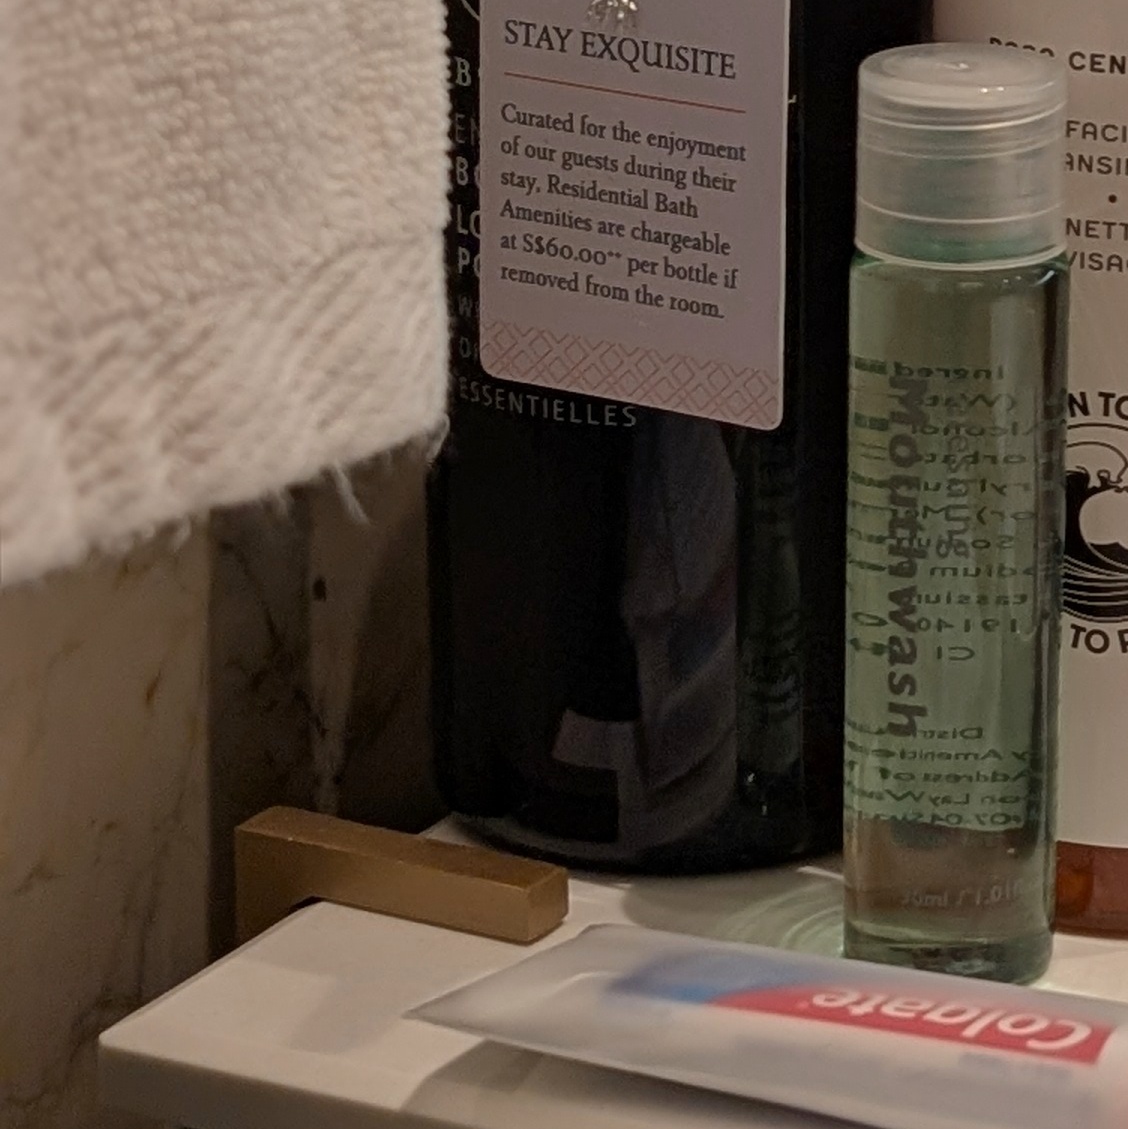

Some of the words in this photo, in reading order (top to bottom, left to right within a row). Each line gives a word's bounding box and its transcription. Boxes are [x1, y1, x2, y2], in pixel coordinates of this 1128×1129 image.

[504, 19, 573, 53] STAY
[580, 31, 737, 80] EXQUISITE
[500, 102, 575, 134] Curated
[579, 114, 606, 140] for
[612, 120, 642, 144] the
[646, 131, 747, 162] enjoyment
[500, 136, 522, 156] of
[524, 143, 557, 162] our
[561, 150, 619, 172] guests
[623, 155, 688, 190] during
[692, 166, 737, 193] their
[500, 170, 541, 196] stay,
[546, 174, 649, 210] Residential
[654, 192, 699, 219] Bath
[500, 199, 593, 232] Amenities
[597, 222, 625, 238] are
[630, 220, 731, 255] chargeable
[500, 234, 517, 250] at
[626, 257, 659, 277] per
[663, 256, 718, 286] bottle
[723, 269, 739, 289] if
[500, 265, 579, 293] removed
[585, 274, 630, 302] from
[635, 284, 665, 308] the
[669, 296, 725, 319] room.
[460, 376, 637, 427] ESSENTIELLES
[887, 375, 930, 738] Mouthwash
[1070, 624, 1110, 654] TO
[811, 987, 1092, 1050] Colgate
